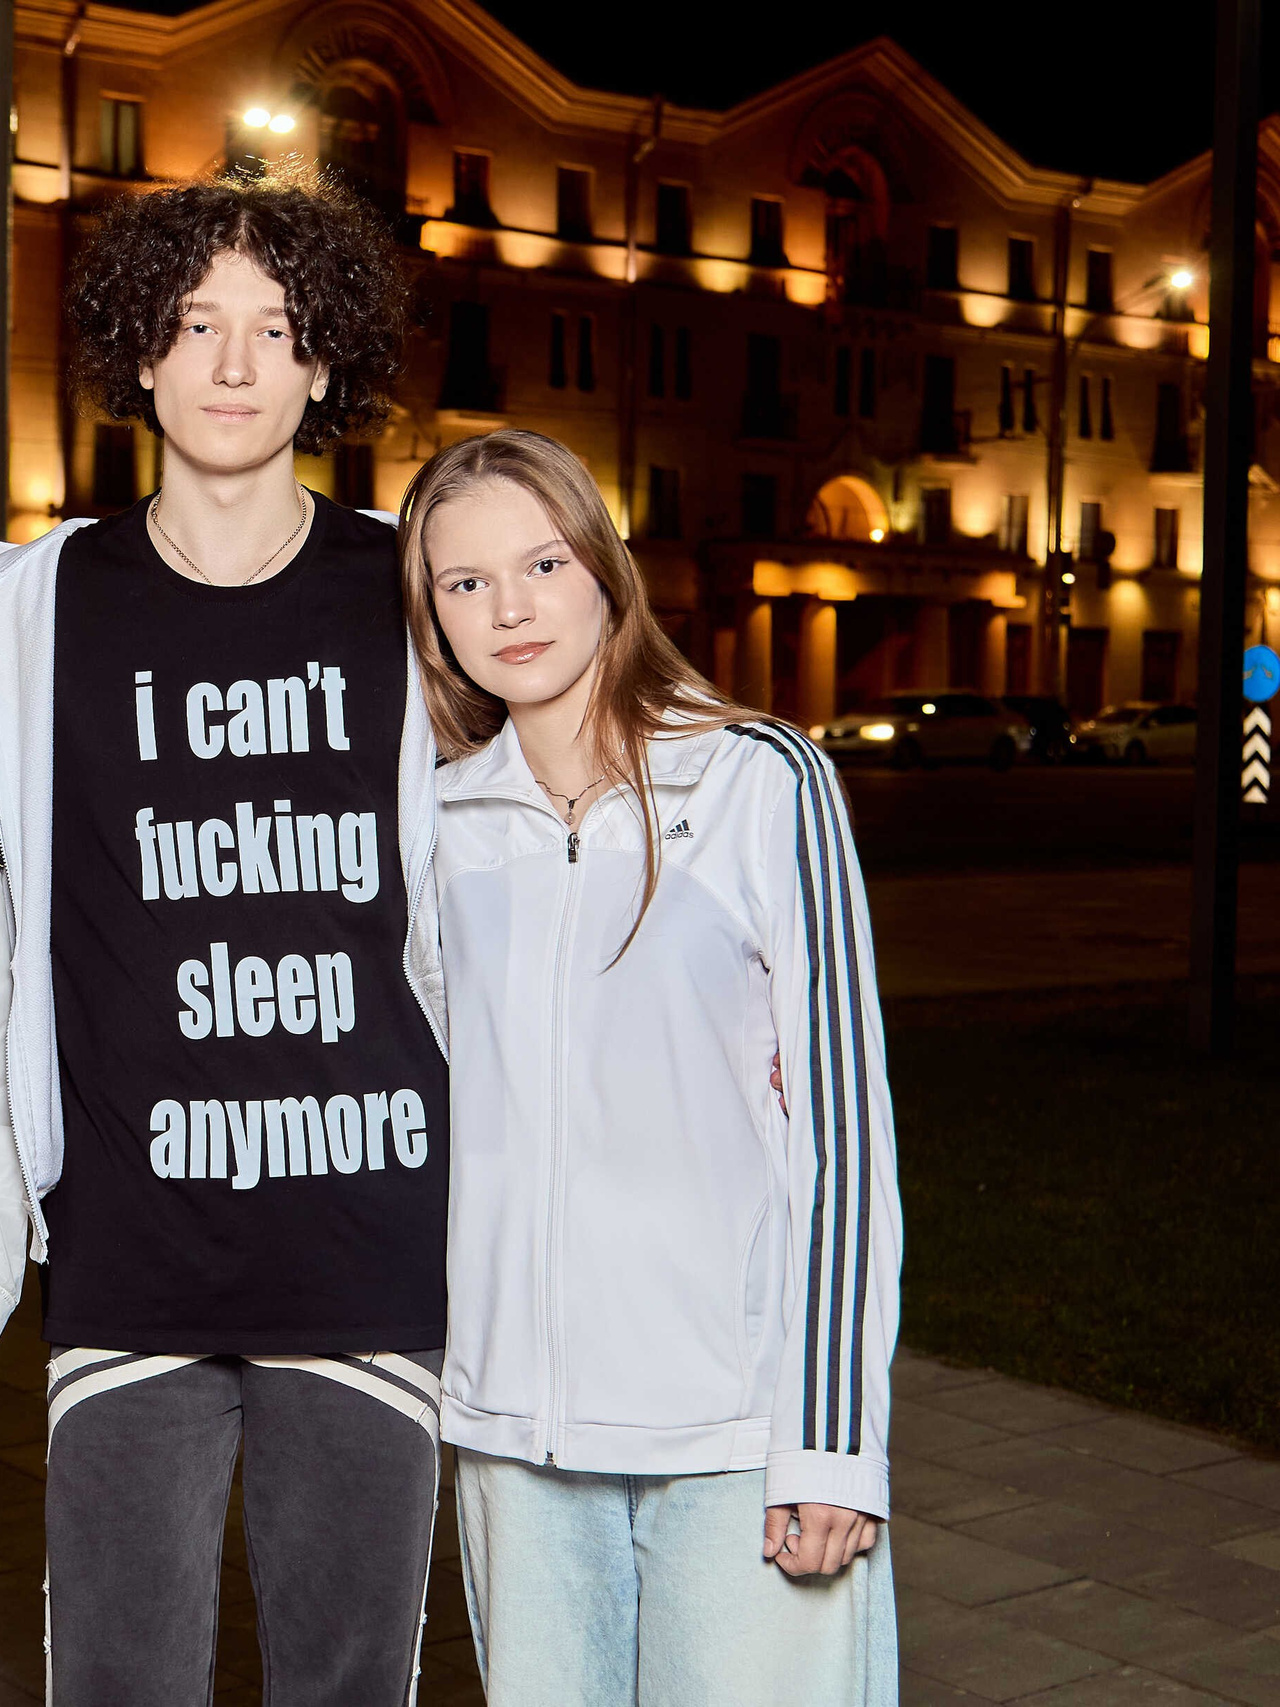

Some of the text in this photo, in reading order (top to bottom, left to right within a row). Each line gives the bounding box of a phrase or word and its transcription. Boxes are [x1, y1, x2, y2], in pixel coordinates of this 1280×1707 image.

[135, 662, 350, 761] i can't
[135, 800, 379, 903] fucking
[177, 942, 355, 1043] sleep
[150, 1089, 428, 1189] anymore
